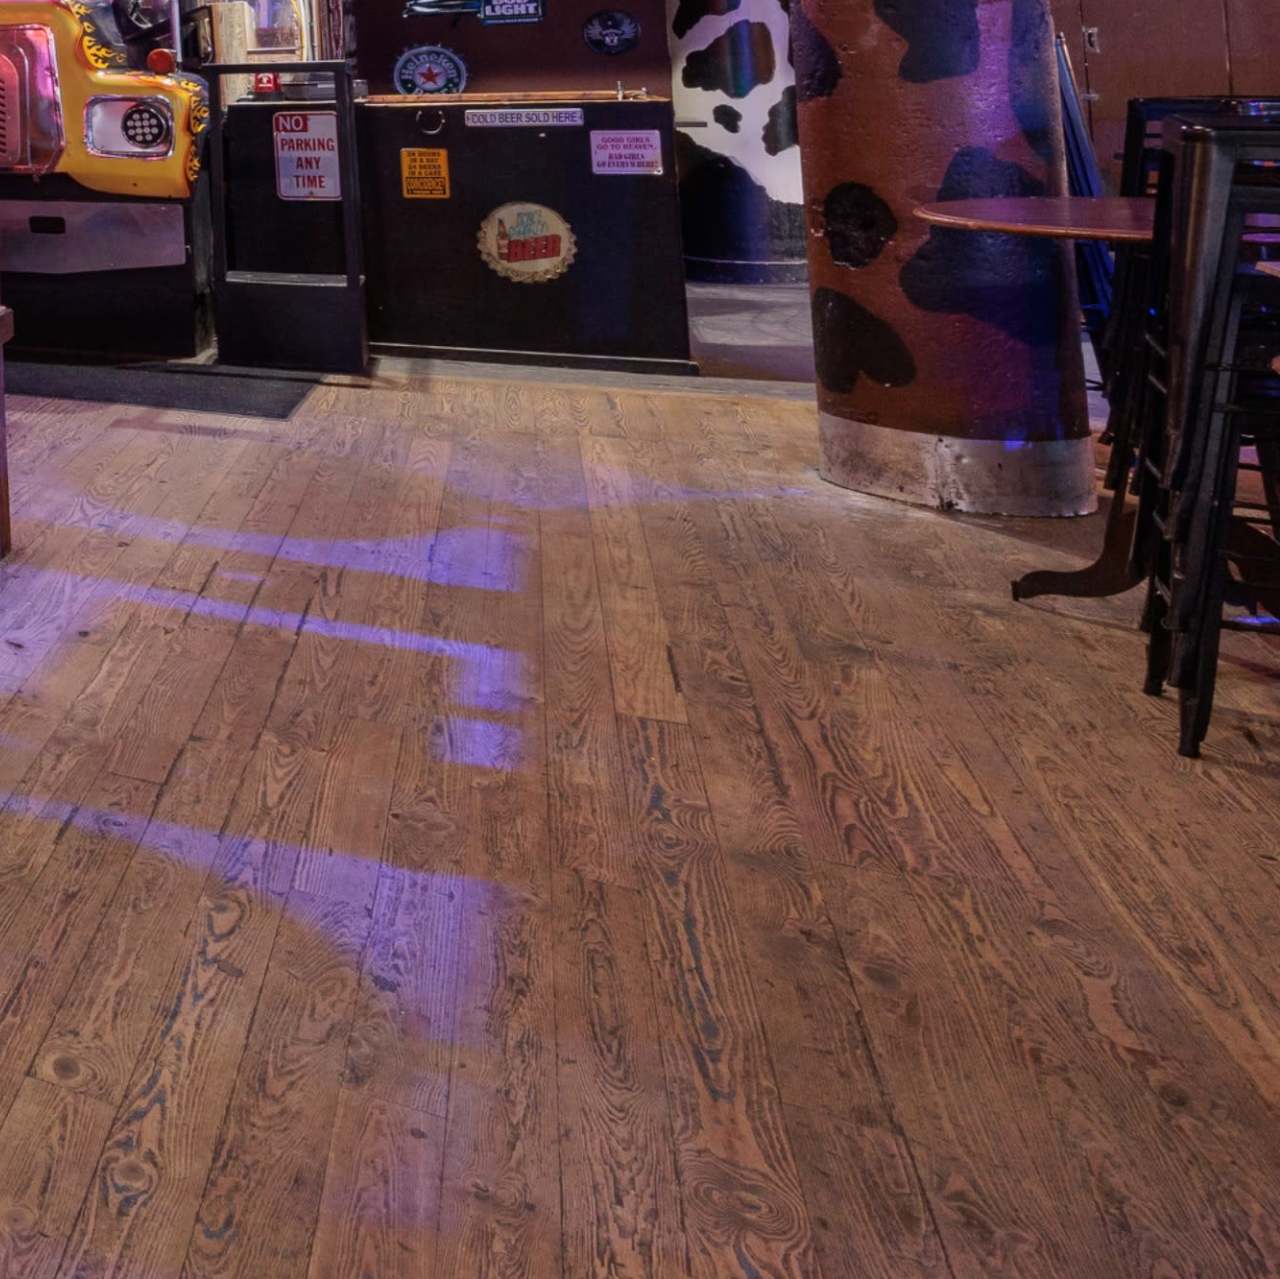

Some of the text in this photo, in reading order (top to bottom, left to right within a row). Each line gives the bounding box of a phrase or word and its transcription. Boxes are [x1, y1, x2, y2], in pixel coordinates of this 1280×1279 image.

[485, 2, 539, 16] LIGHT
[400, 53, 460, 83] Heineken
[278, 115, 304, 131] NO
[472, 111, 577, 124] COLD BEER SOLD HERE
[280, 137, 335, 152] PARKING
[295, 156, 321, 170] ANY
[293, 174, 327, 189] TIME
